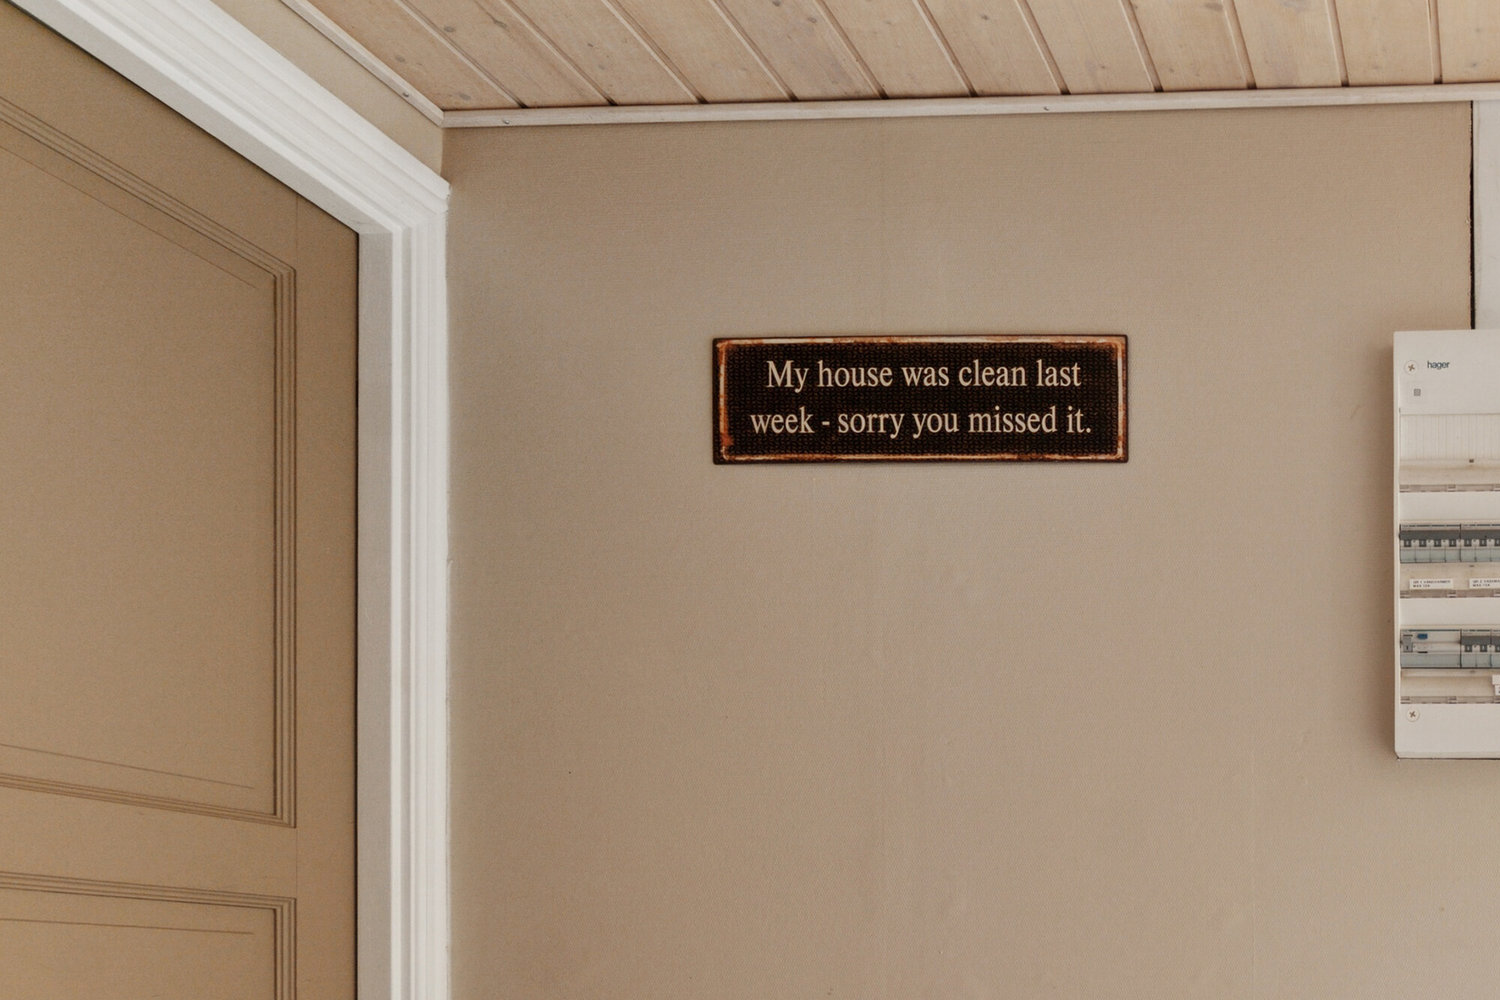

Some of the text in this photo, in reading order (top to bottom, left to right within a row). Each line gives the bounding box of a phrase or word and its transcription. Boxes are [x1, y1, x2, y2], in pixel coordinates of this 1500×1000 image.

[766, 358, 1082, 394] My house was clean last
[1427, 360, 1450, 370] hager
[750, 406, 815, 434] week
[837, 413, 905, 440] sorry
[912, 413, 960, 439] you
[968, 405, 1058, 434] missed
[1066, 405, 1092, 434] it.
